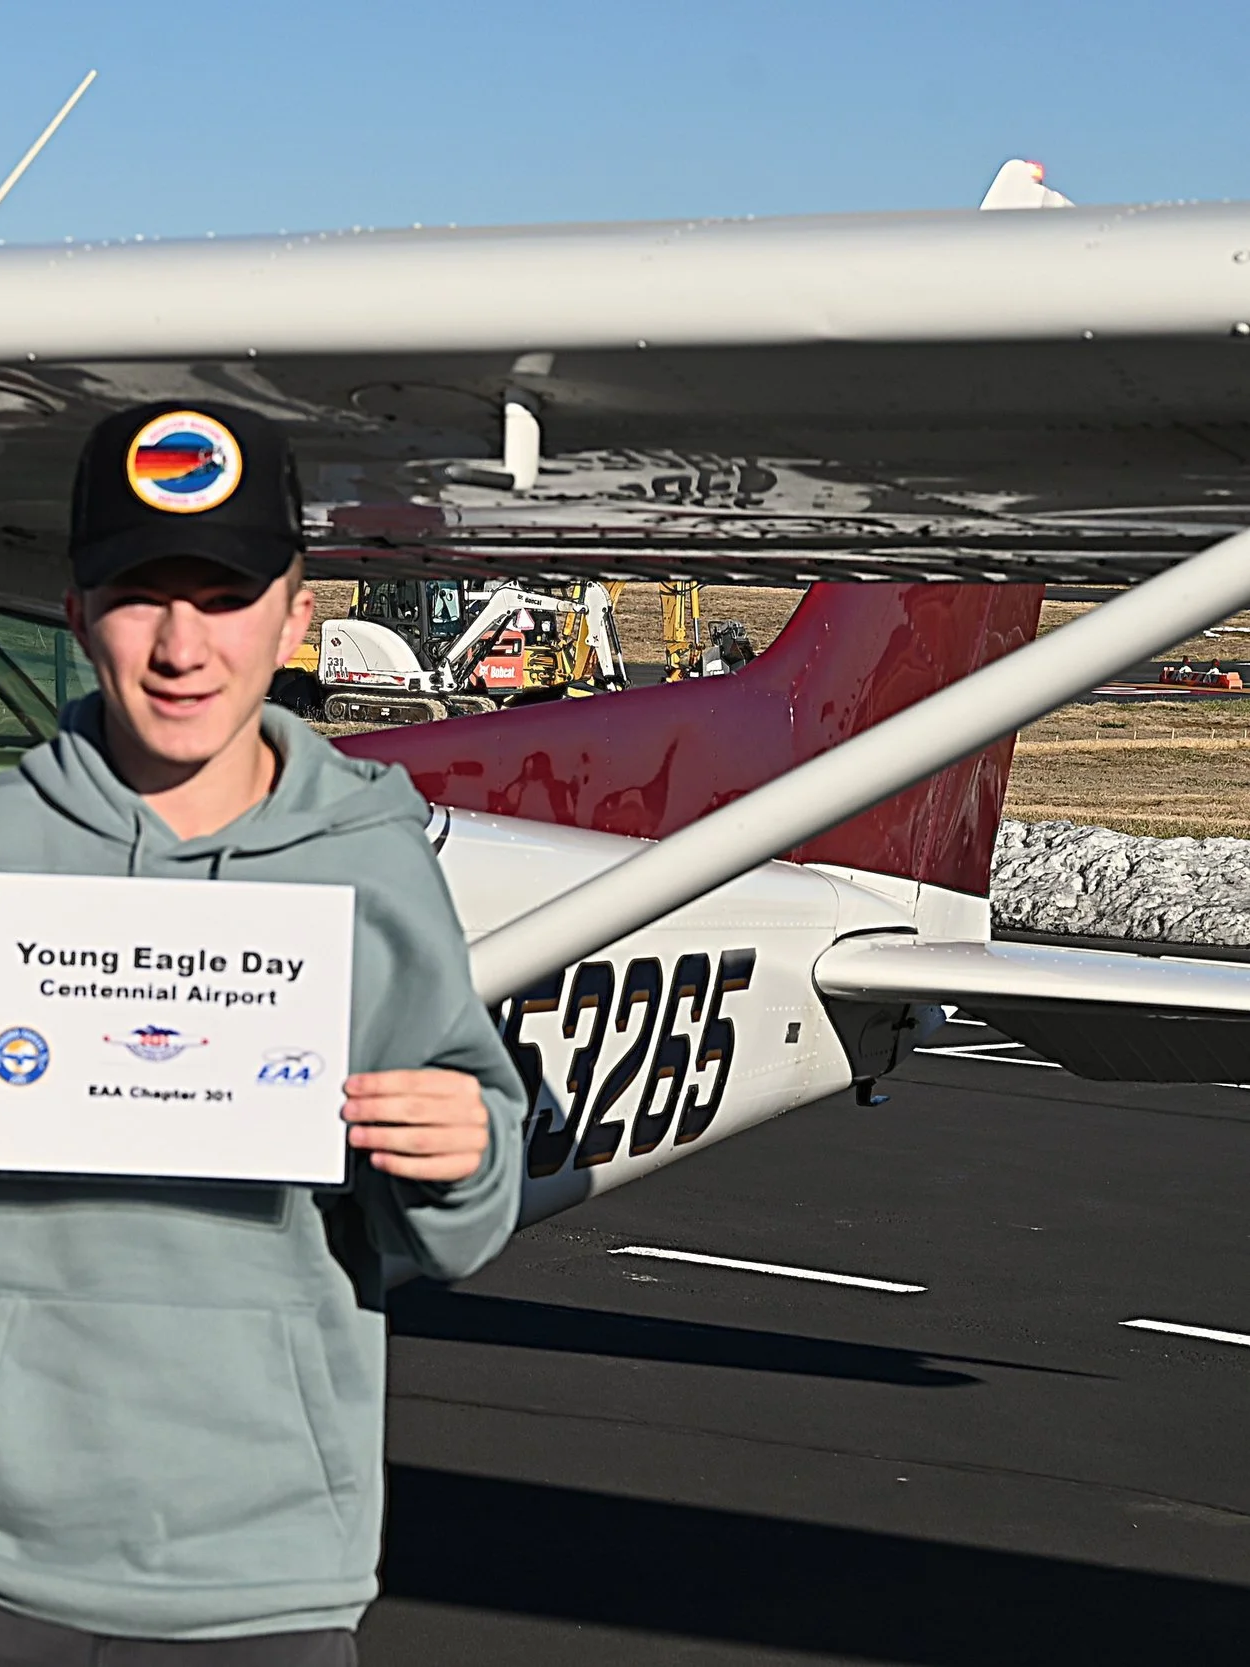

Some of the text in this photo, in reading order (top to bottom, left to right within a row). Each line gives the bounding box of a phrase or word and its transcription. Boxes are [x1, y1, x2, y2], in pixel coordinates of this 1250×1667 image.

[490, 666, 516, 679] Bobcat
[17, 942, 304, 982] Young Eagle Day
[40, 979, 276, 1007] Centennial Airport
[258, 1064, 311, 1081] EAA
[488, 948, 757, 1179] 53265
[89, 1085, 232, 1101] EAA Chapter 301
